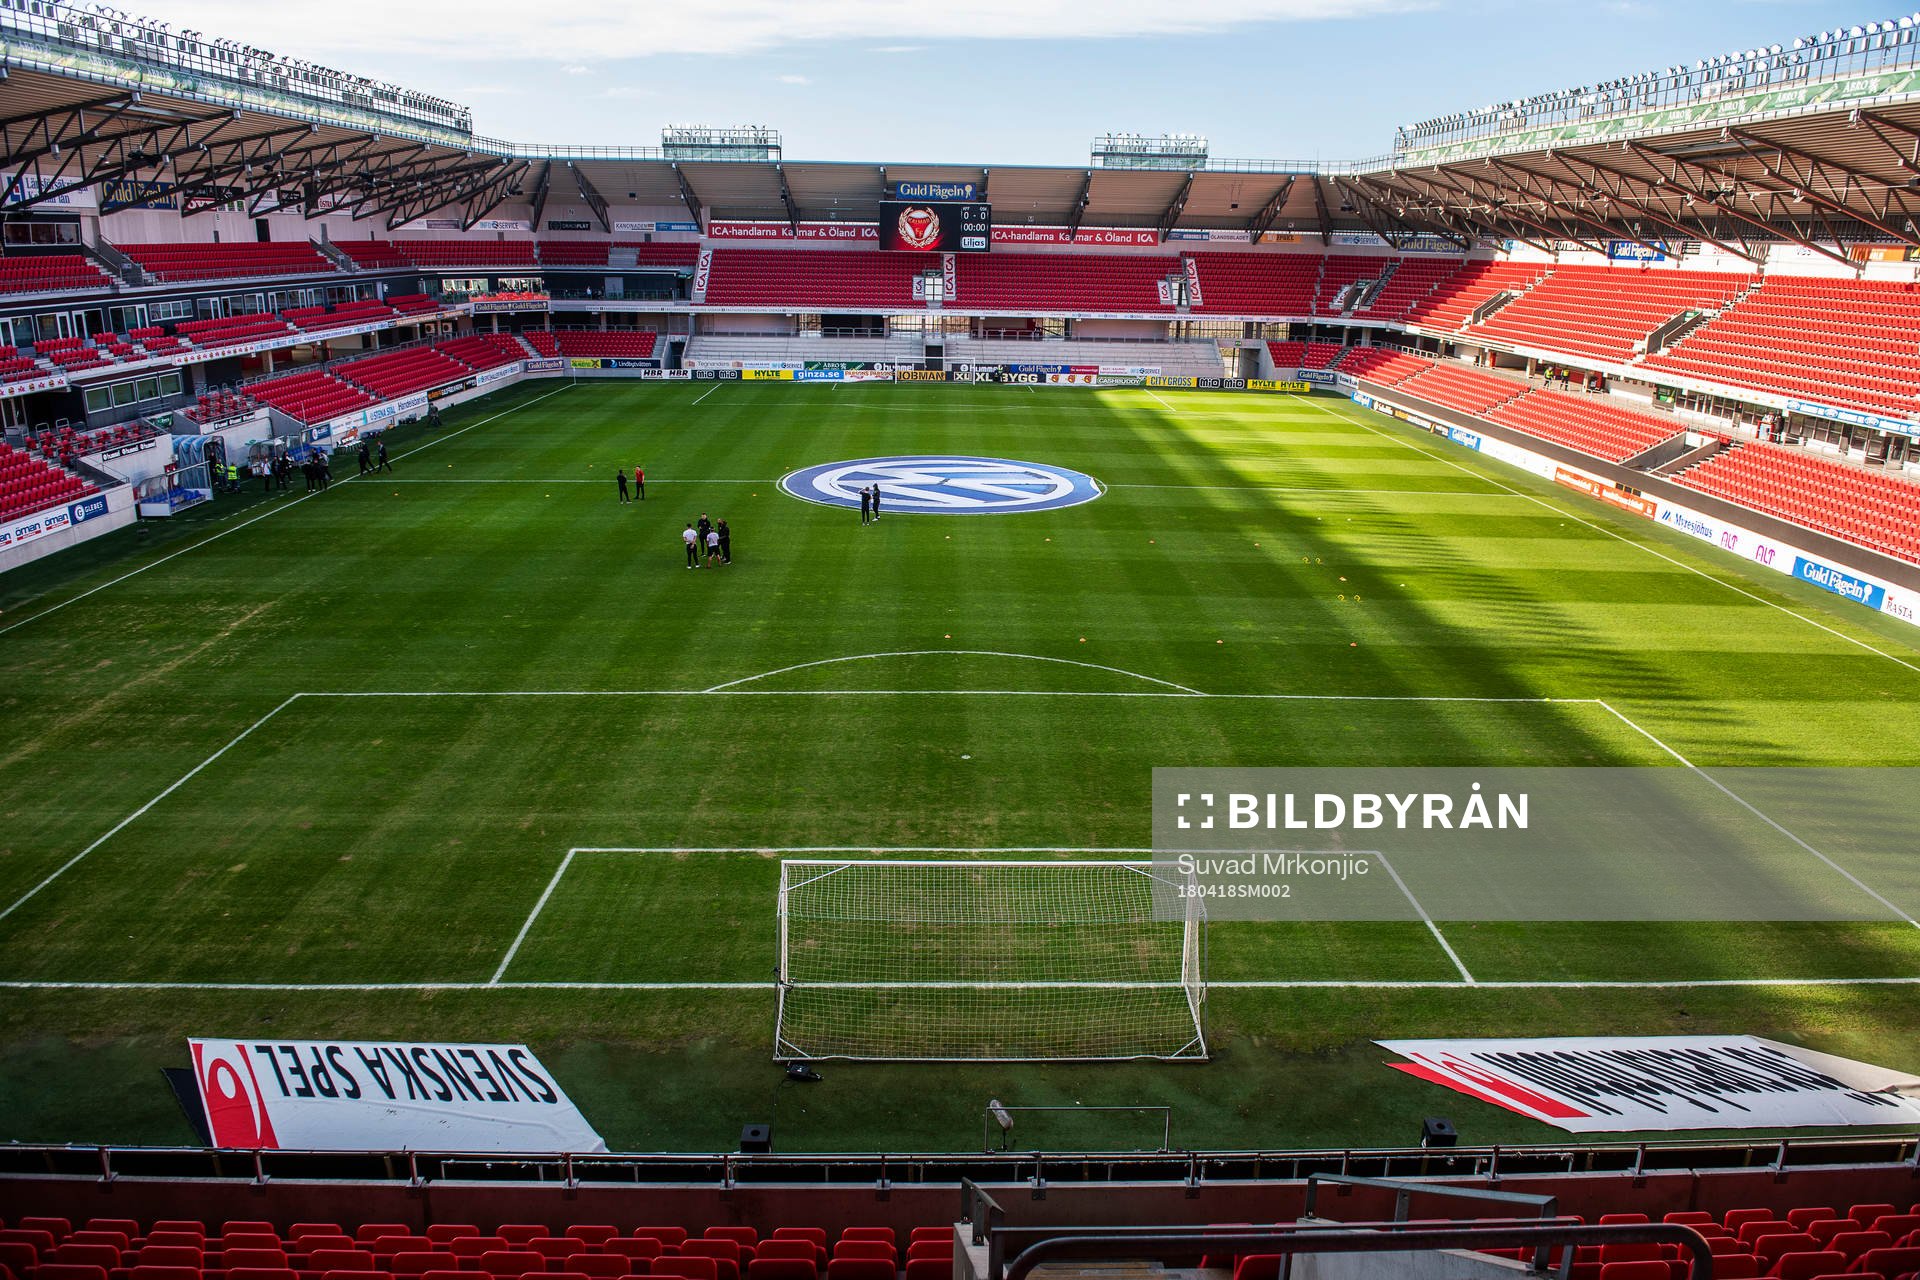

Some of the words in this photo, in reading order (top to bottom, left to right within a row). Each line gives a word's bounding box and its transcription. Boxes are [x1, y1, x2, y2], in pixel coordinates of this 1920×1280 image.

[900, 183, 927, 196] Guld
[929, 184, 964, 200] Fågeln
[963, 211, 970, 220] 0
[980, 211, 986, 220] 0
[711, 227, 777, 237] ICA-handlarna
[819, 228, 826, 238] &
[828, 226, 856, 238] Öland
[861, 227, 878, 238] ICA
[963, 223, 986, 232] 00:00
[963, 238, 985, 248] Liljas
[991, 231, 1055, 242] ICA-handlarna
[1058, 232, 1093, 243] Kamar
[1095, 233, 1103, 243] &
[1105, 230, 1132, 243] Öland
[1137, 233, 1154, 243] ICA
[798, 370, 840, 379] ginza.se
[1252, 380, 1276, 388] HYLTE
[1280, 381, 1305, 389] HYLTE
[44, 513, 69, 527] öman
[1675, 513, 1713, 539] Myresjöhus
[15, 522, 41, 537] öman
[1803, 562, 1829, 584] Guld
[1829, 572, 1863, 598] Fågeln
[1886, 600, 1913, 620] RASTA
[254, 1045, 361, 1100] SPEL
[353, 1046, 558, 1104] SVENSKA
